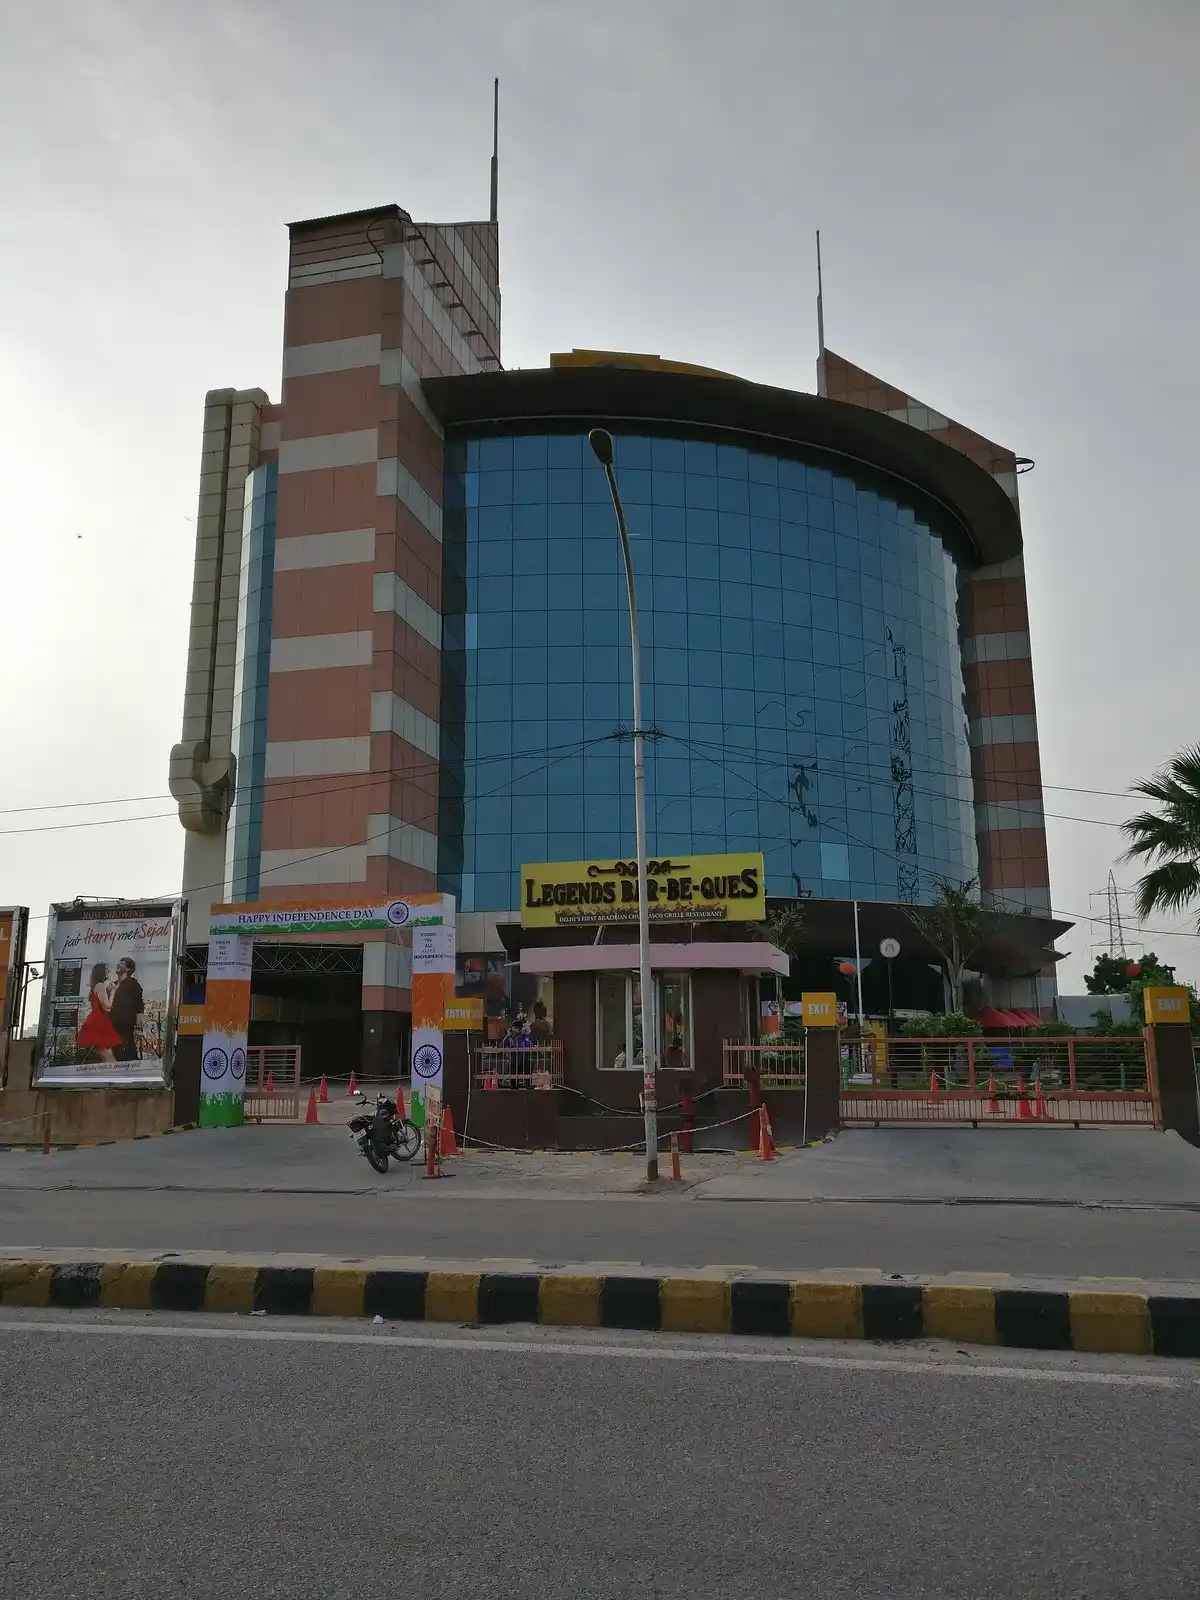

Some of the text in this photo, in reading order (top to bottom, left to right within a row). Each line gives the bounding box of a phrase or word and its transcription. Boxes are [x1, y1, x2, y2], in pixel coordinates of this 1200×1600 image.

[525, 878, 616, 907] LEGENDS
[238, 907, 375, 924] HAPPY INDEPENDENCE DAY
[83, 927, 116, 950] Harry
[140, 920, 169, 944] Sejal
[808, 1003, 829, 1016] EXIT
